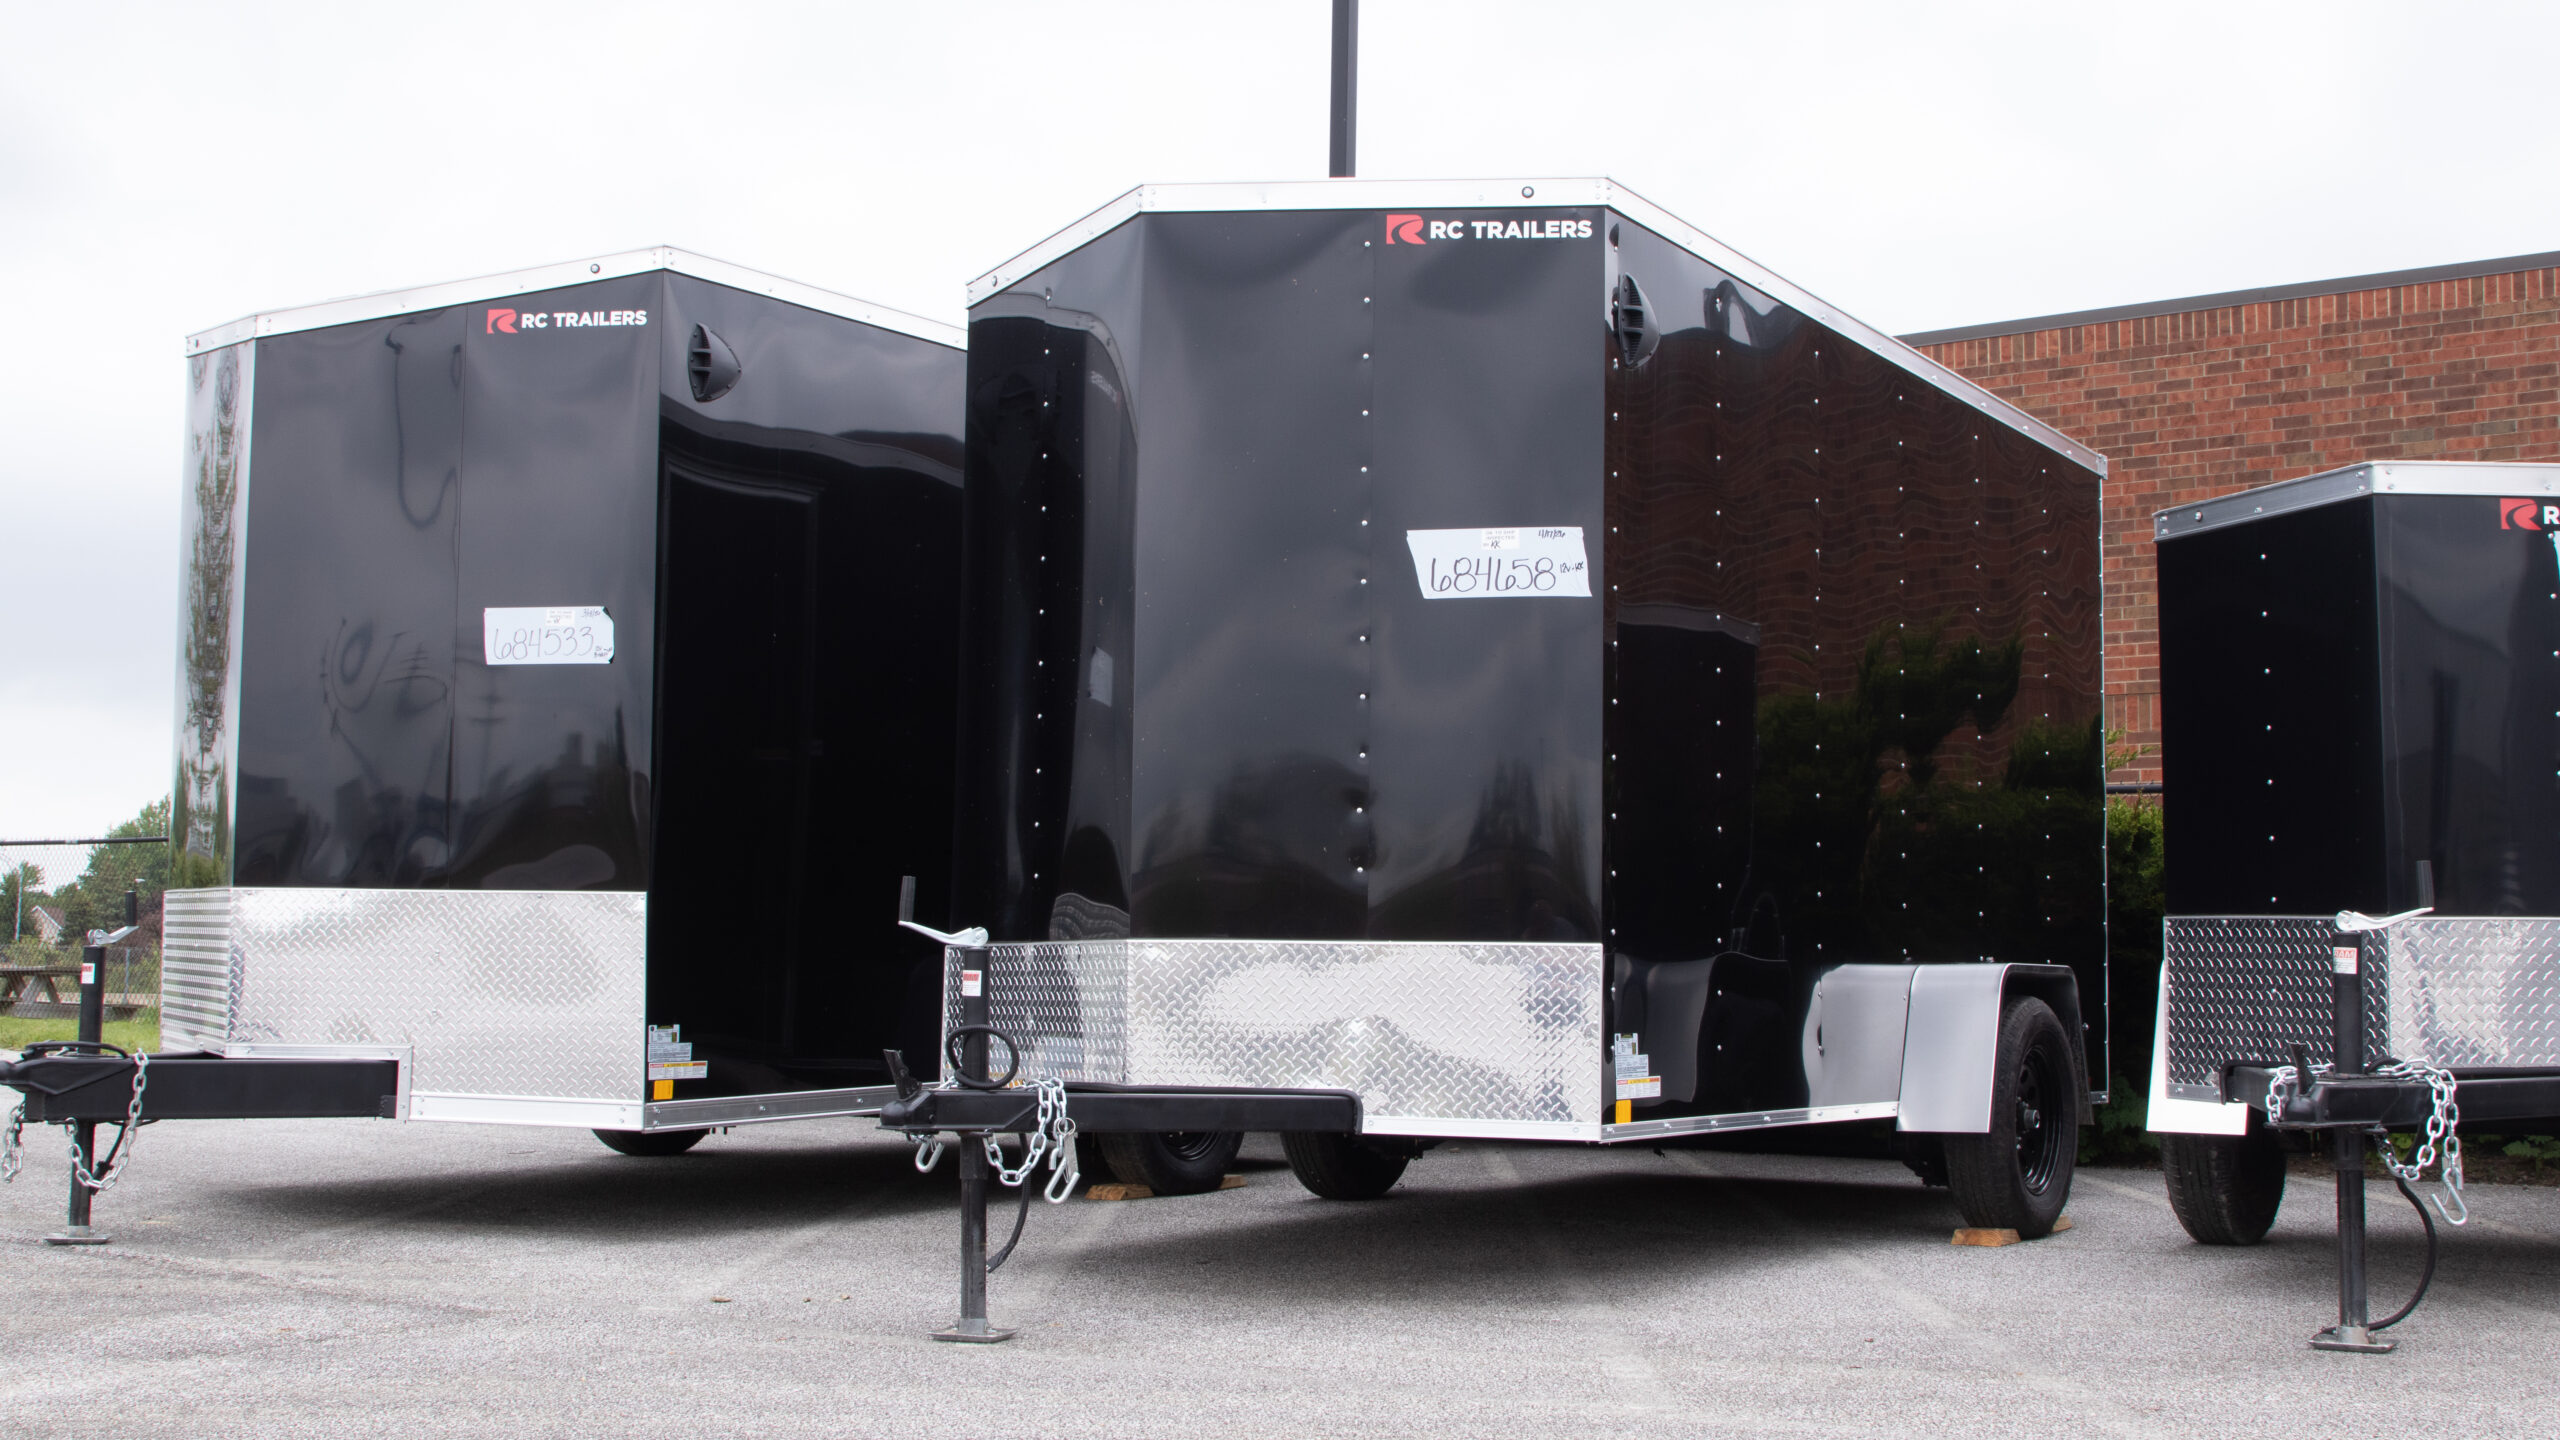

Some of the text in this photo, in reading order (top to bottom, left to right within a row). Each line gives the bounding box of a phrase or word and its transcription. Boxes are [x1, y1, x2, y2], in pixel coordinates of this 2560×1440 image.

[1430, 221, 1464, 239] RC
[1471, 220, 1593, 239] TRAILERS
[521, 313, 548, 328] RC
[553, 310, 648, 328] TRAILERS
[1431, 556, 1556, 592] 684658
[493, 626, 595, 660] 684533
